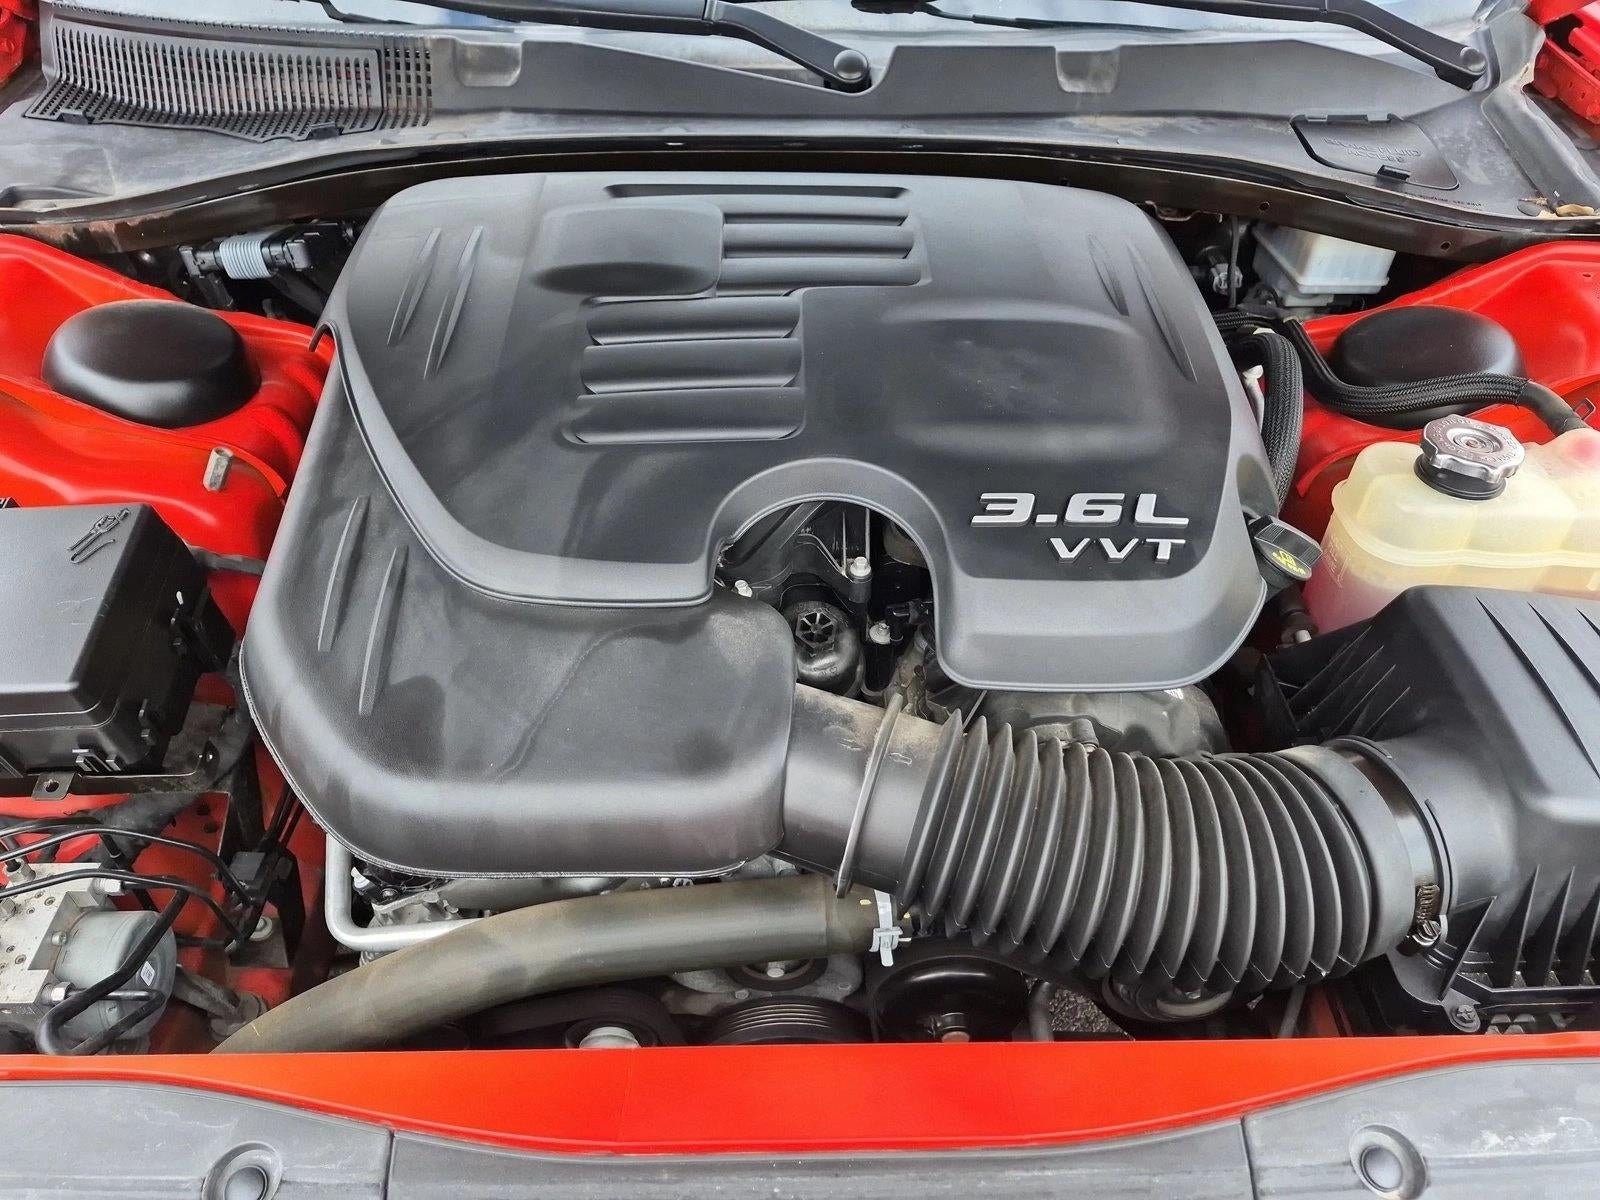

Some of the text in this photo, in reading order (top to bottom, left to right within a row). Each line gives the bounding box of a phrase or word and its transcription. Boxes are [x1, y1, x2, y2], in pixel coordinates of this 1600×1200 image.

[1377, 145, 1422, 157] FLUID
[971, 492, 1189, 527] 3.6L
[1050, 537, 1187, 563] VVT
